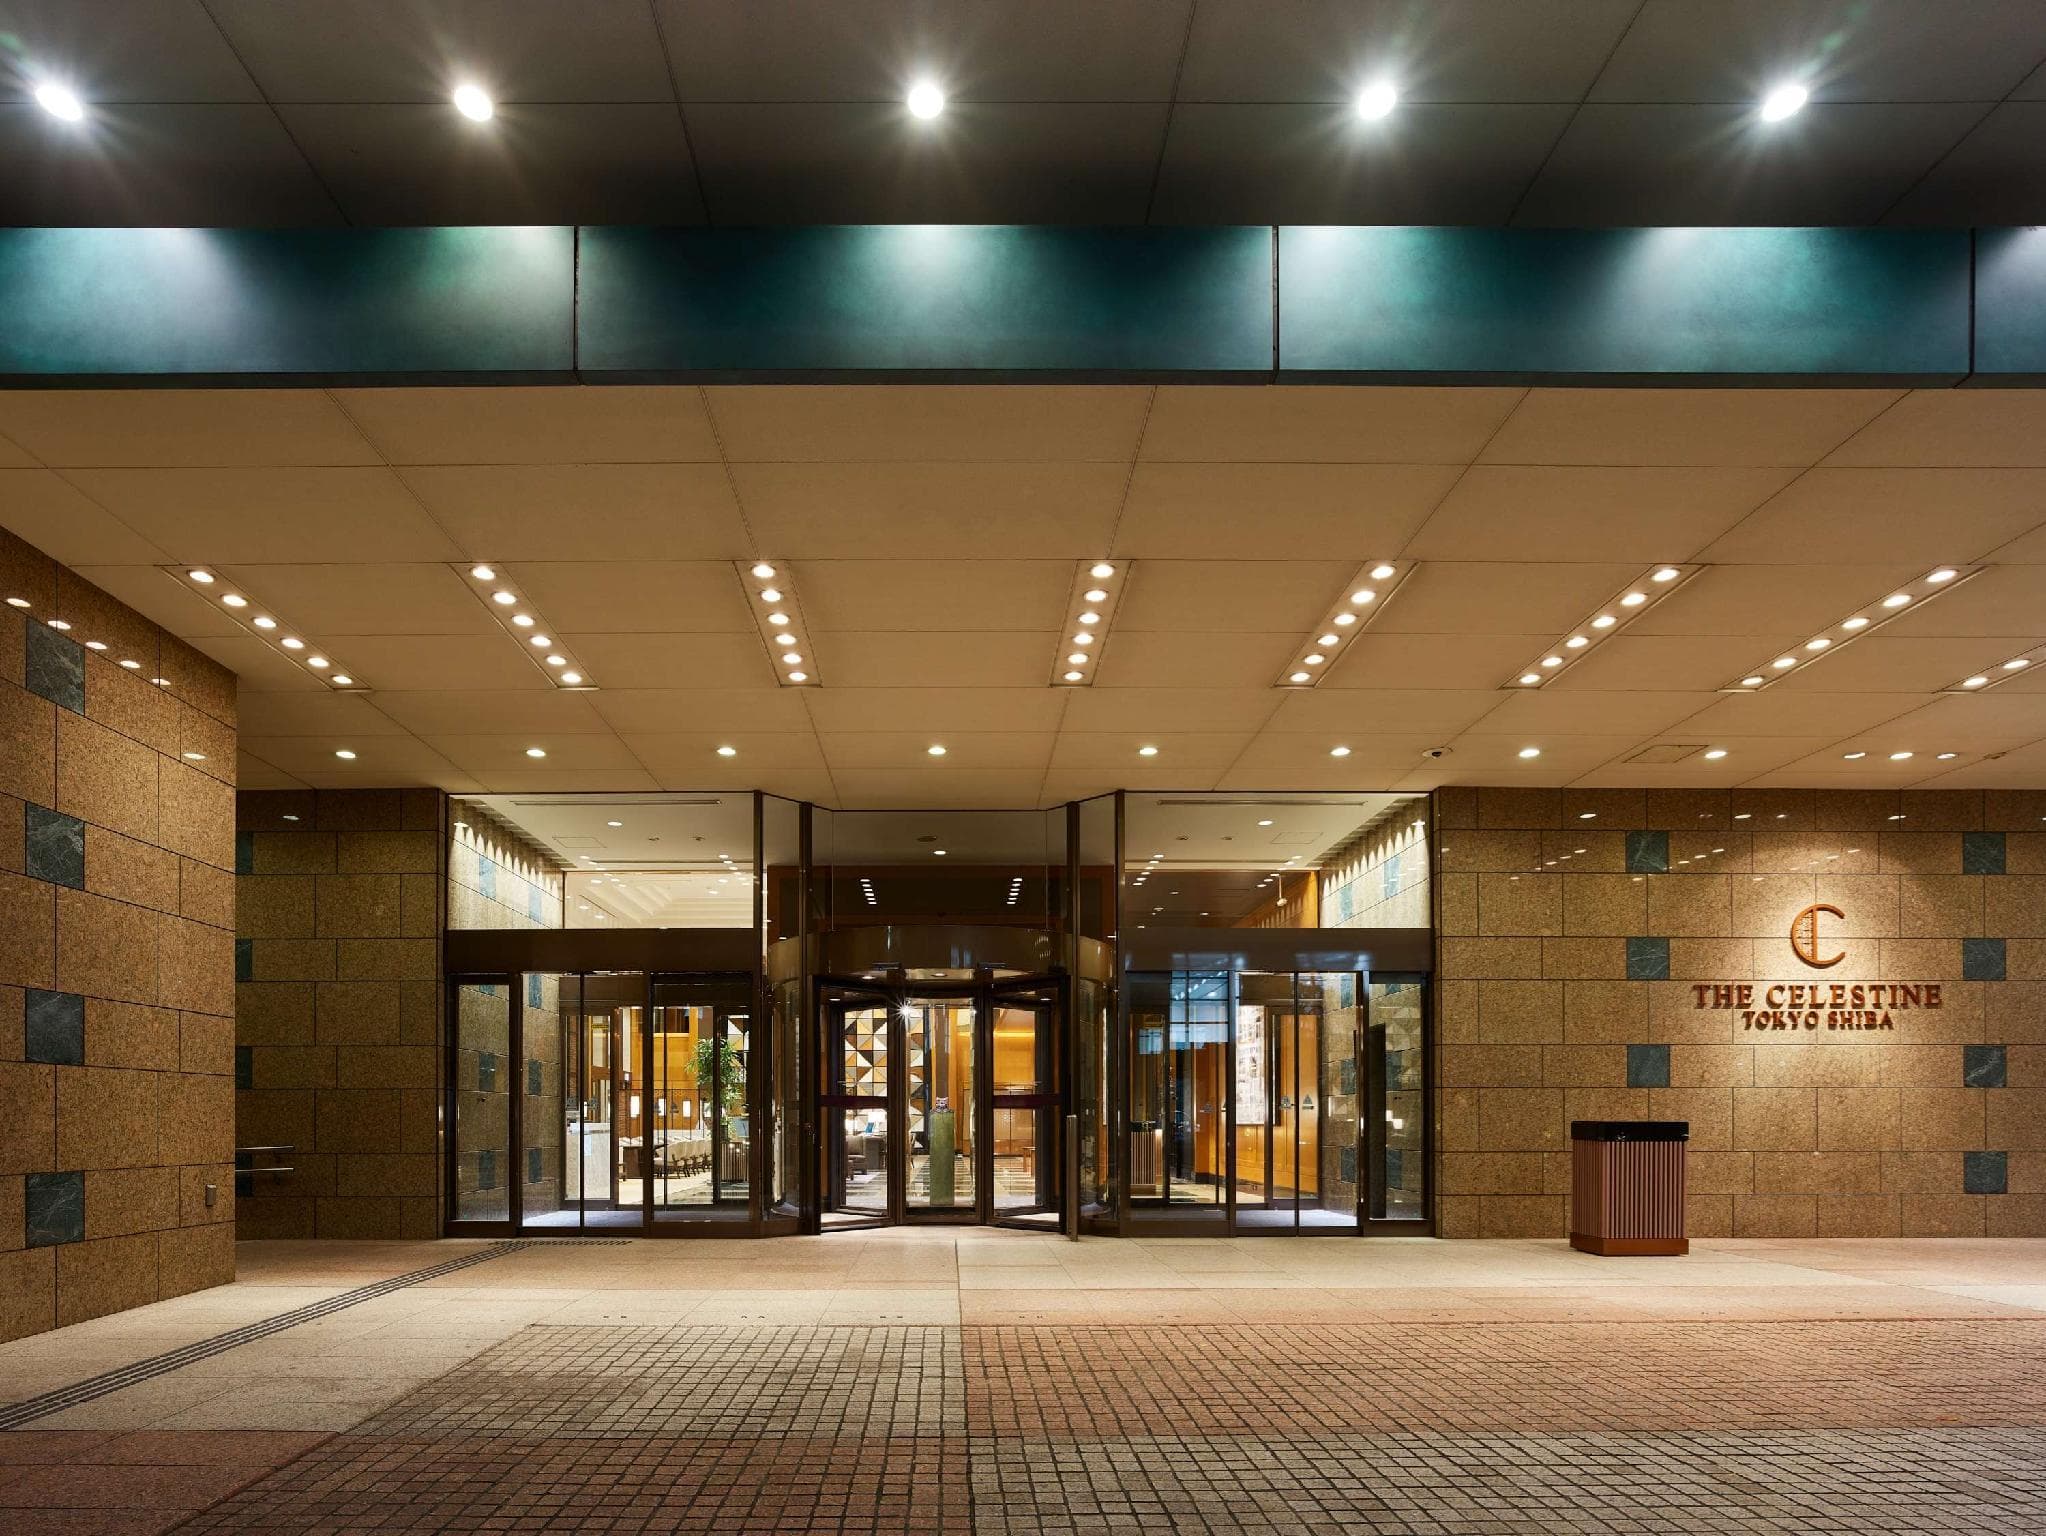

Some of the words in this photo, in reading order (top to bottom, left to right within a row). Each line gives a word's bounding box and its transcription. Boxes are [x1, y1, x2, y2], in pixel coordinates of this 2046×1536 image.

[1693, 985, 1753, 1008] THE
[1766, 985, 1941, 1008] CELESTINE
[1742, 1011, 1818, 1029] TOKYO
[1828, 1011, 1893, 1029] SHIBA
